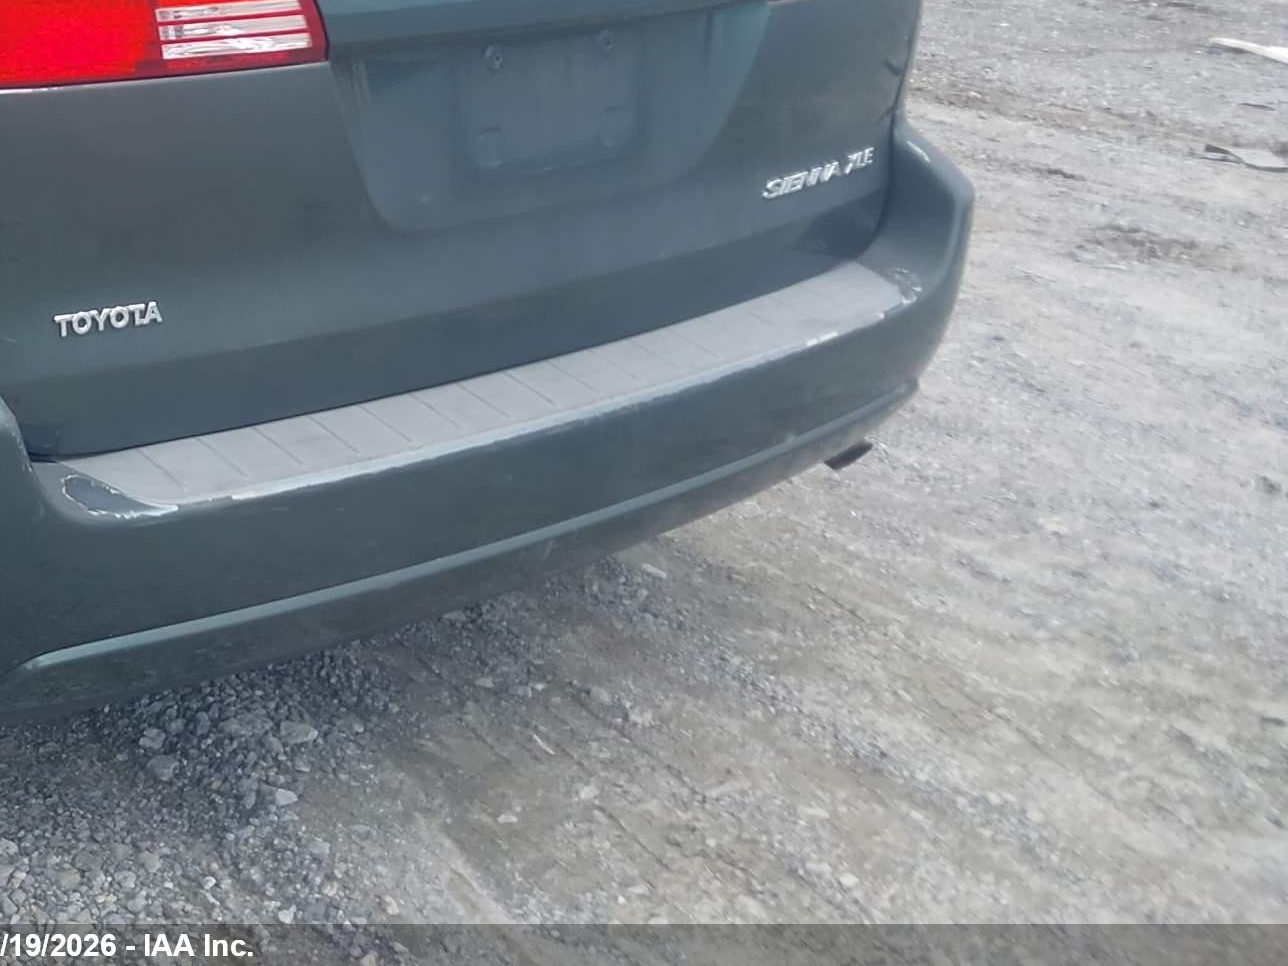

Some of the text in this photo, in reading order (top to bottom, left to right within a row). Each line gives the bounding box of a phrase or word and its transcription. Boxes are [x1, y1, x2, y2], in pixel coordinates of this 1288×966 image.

[761, 146, 875, 199] SIENNA XLE
[53, 300, 164, 338] TOYOTA
